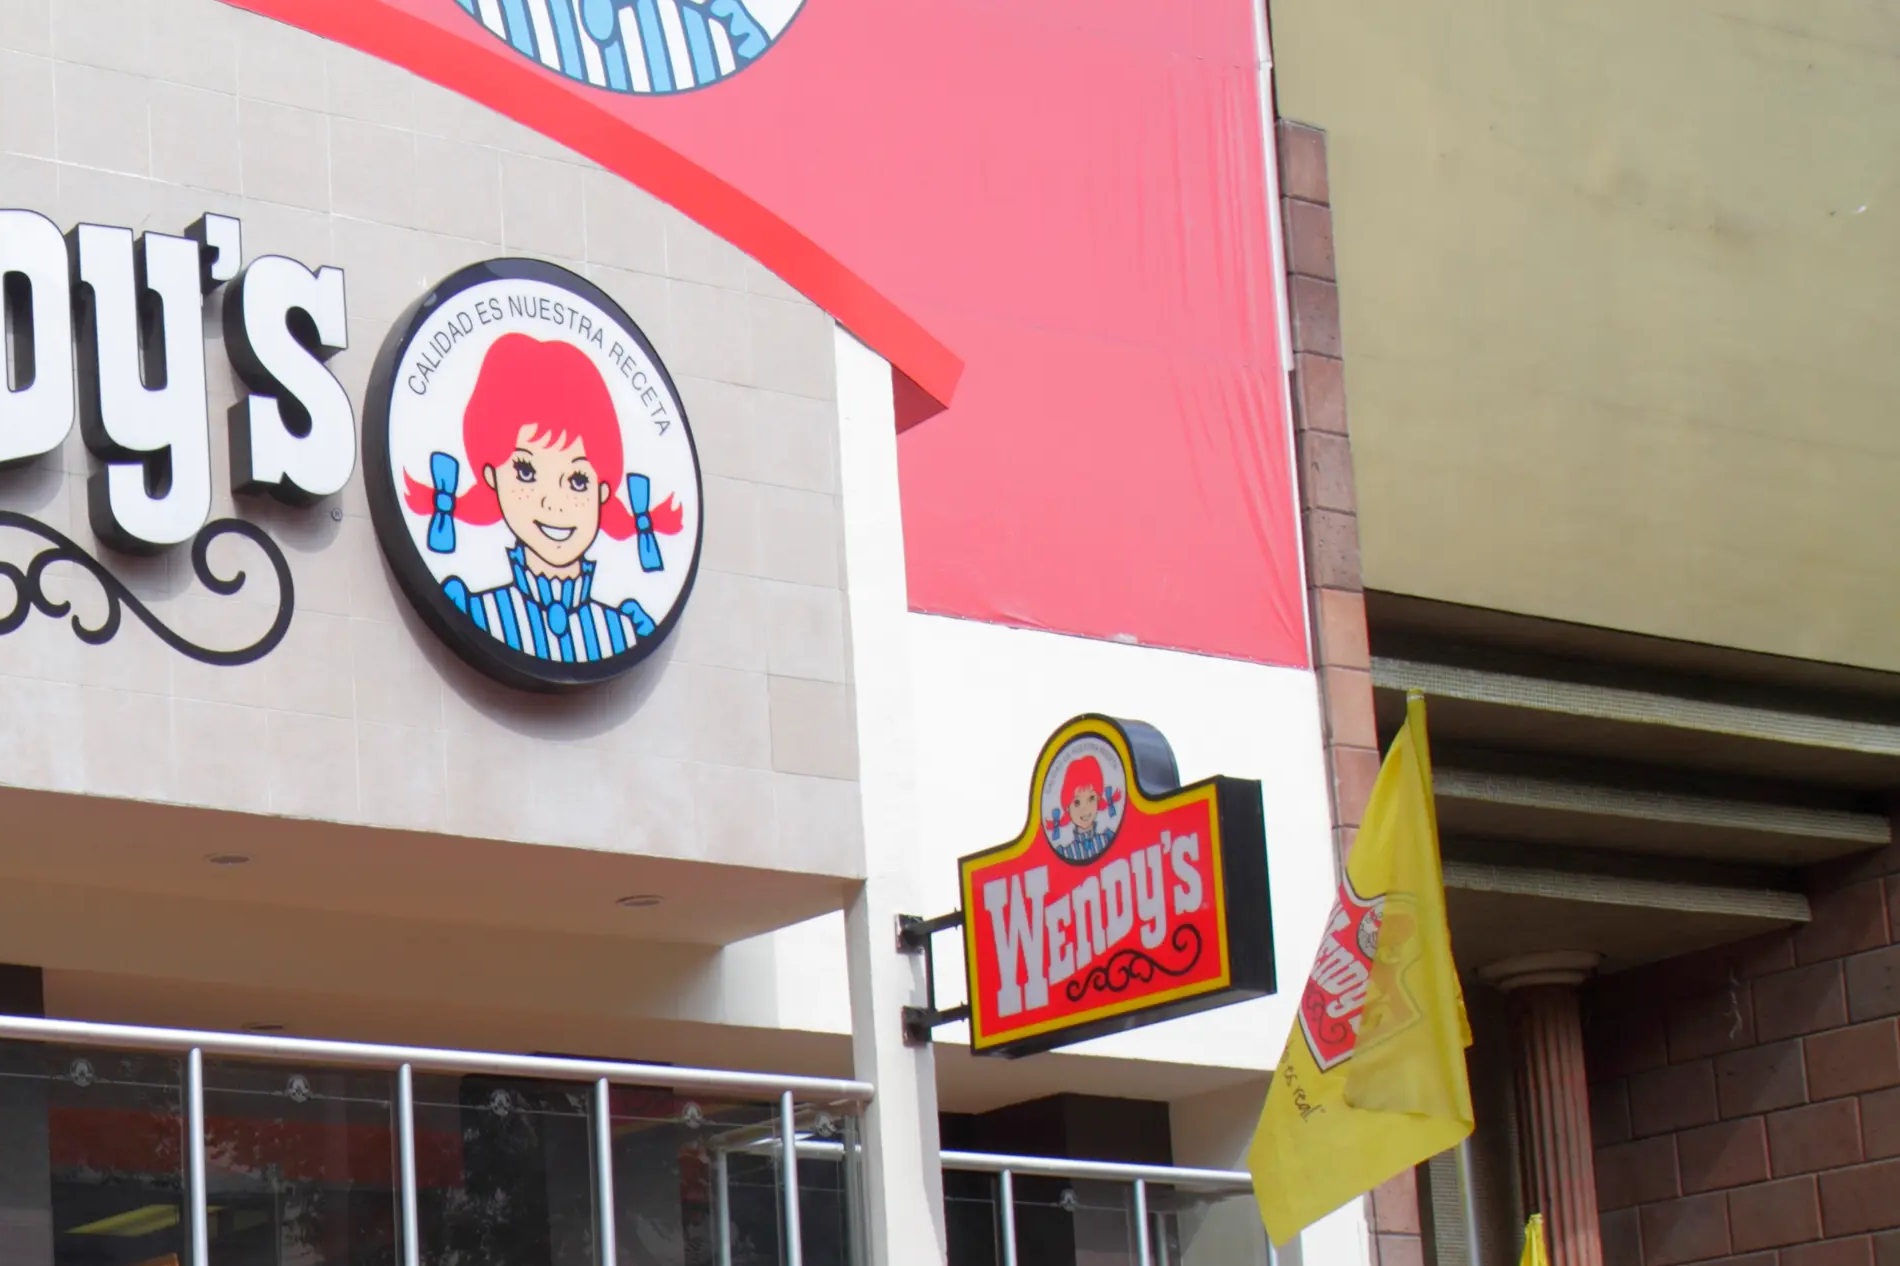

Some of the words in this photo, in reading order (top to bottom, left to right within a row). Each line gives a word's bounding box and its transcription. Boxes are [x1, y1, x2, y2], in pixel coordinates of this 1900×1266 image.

[408, 311, 474, 396] CALIDAD
[475, 298, 503, 325] ES
[508, 295, 603, 350] NUESTRA
[608, 342, 671, 436] RECETA
[982, 830, 1204, 1017] Wendy's
